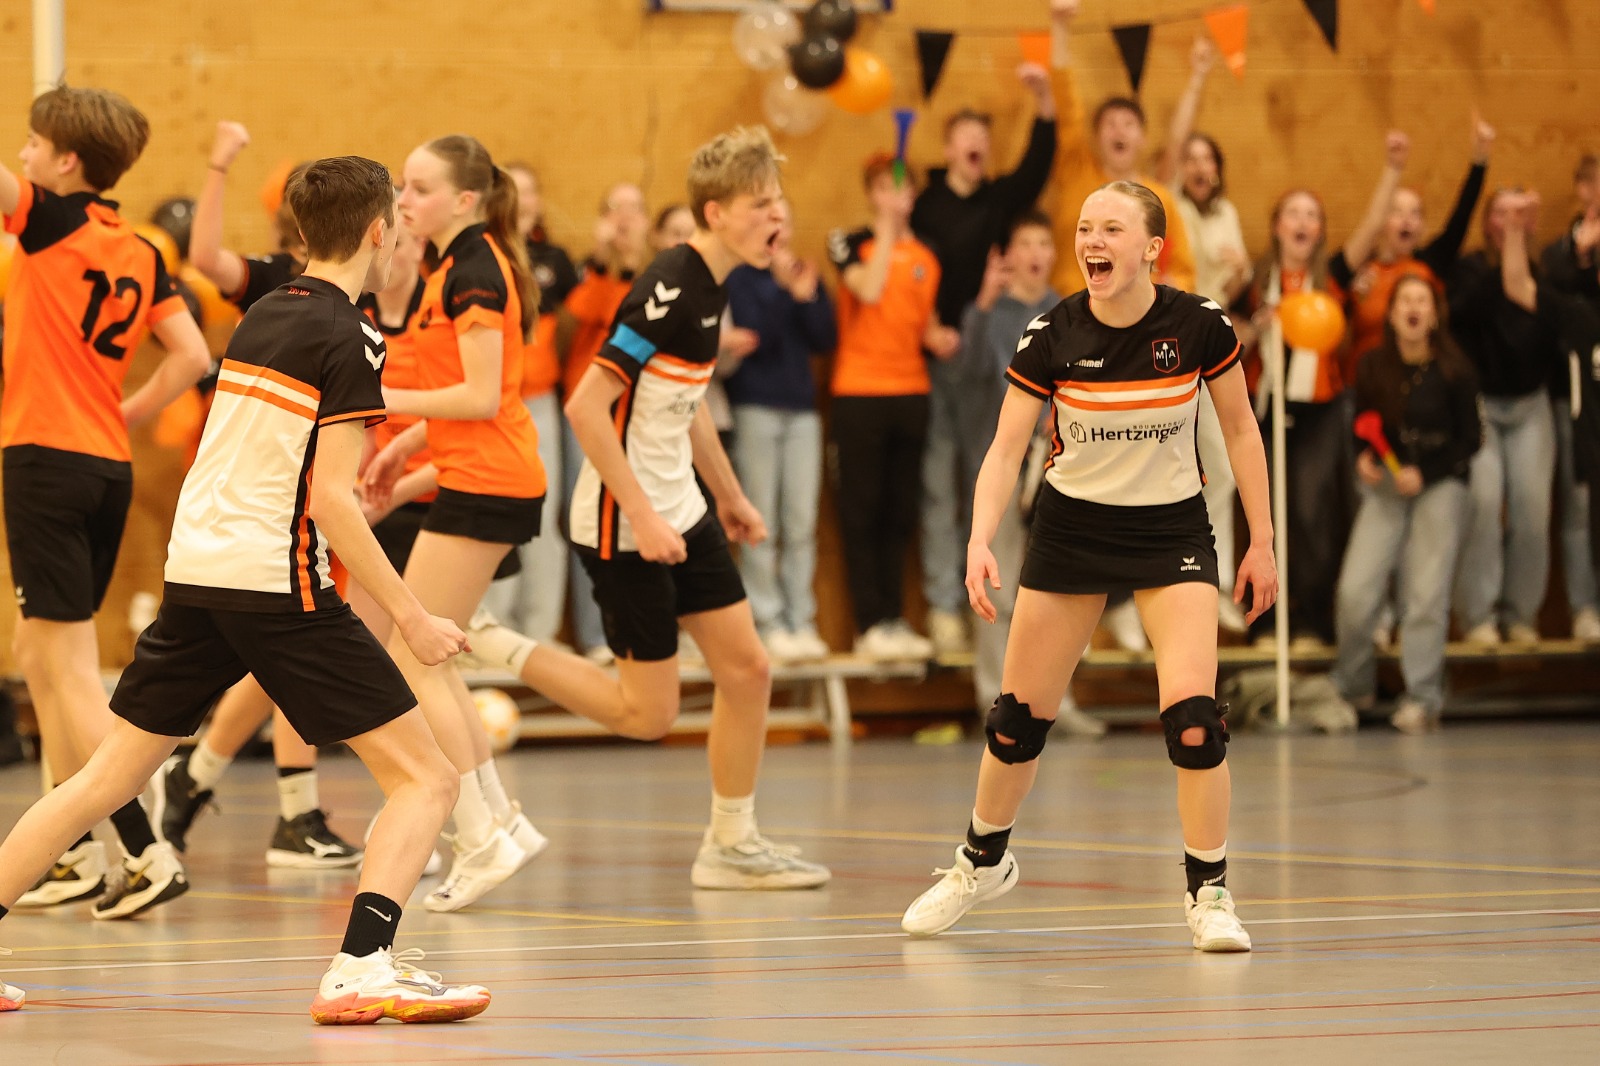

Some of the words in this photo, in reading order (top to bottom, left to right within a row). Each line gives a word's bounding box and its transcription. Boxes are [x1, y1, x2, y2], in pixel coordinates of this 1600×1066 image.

[80, 268, 143, 361] 12
[1066, 357, 1104, 368] mmel
[1090, 422, 1184, 444] Hertzinger
